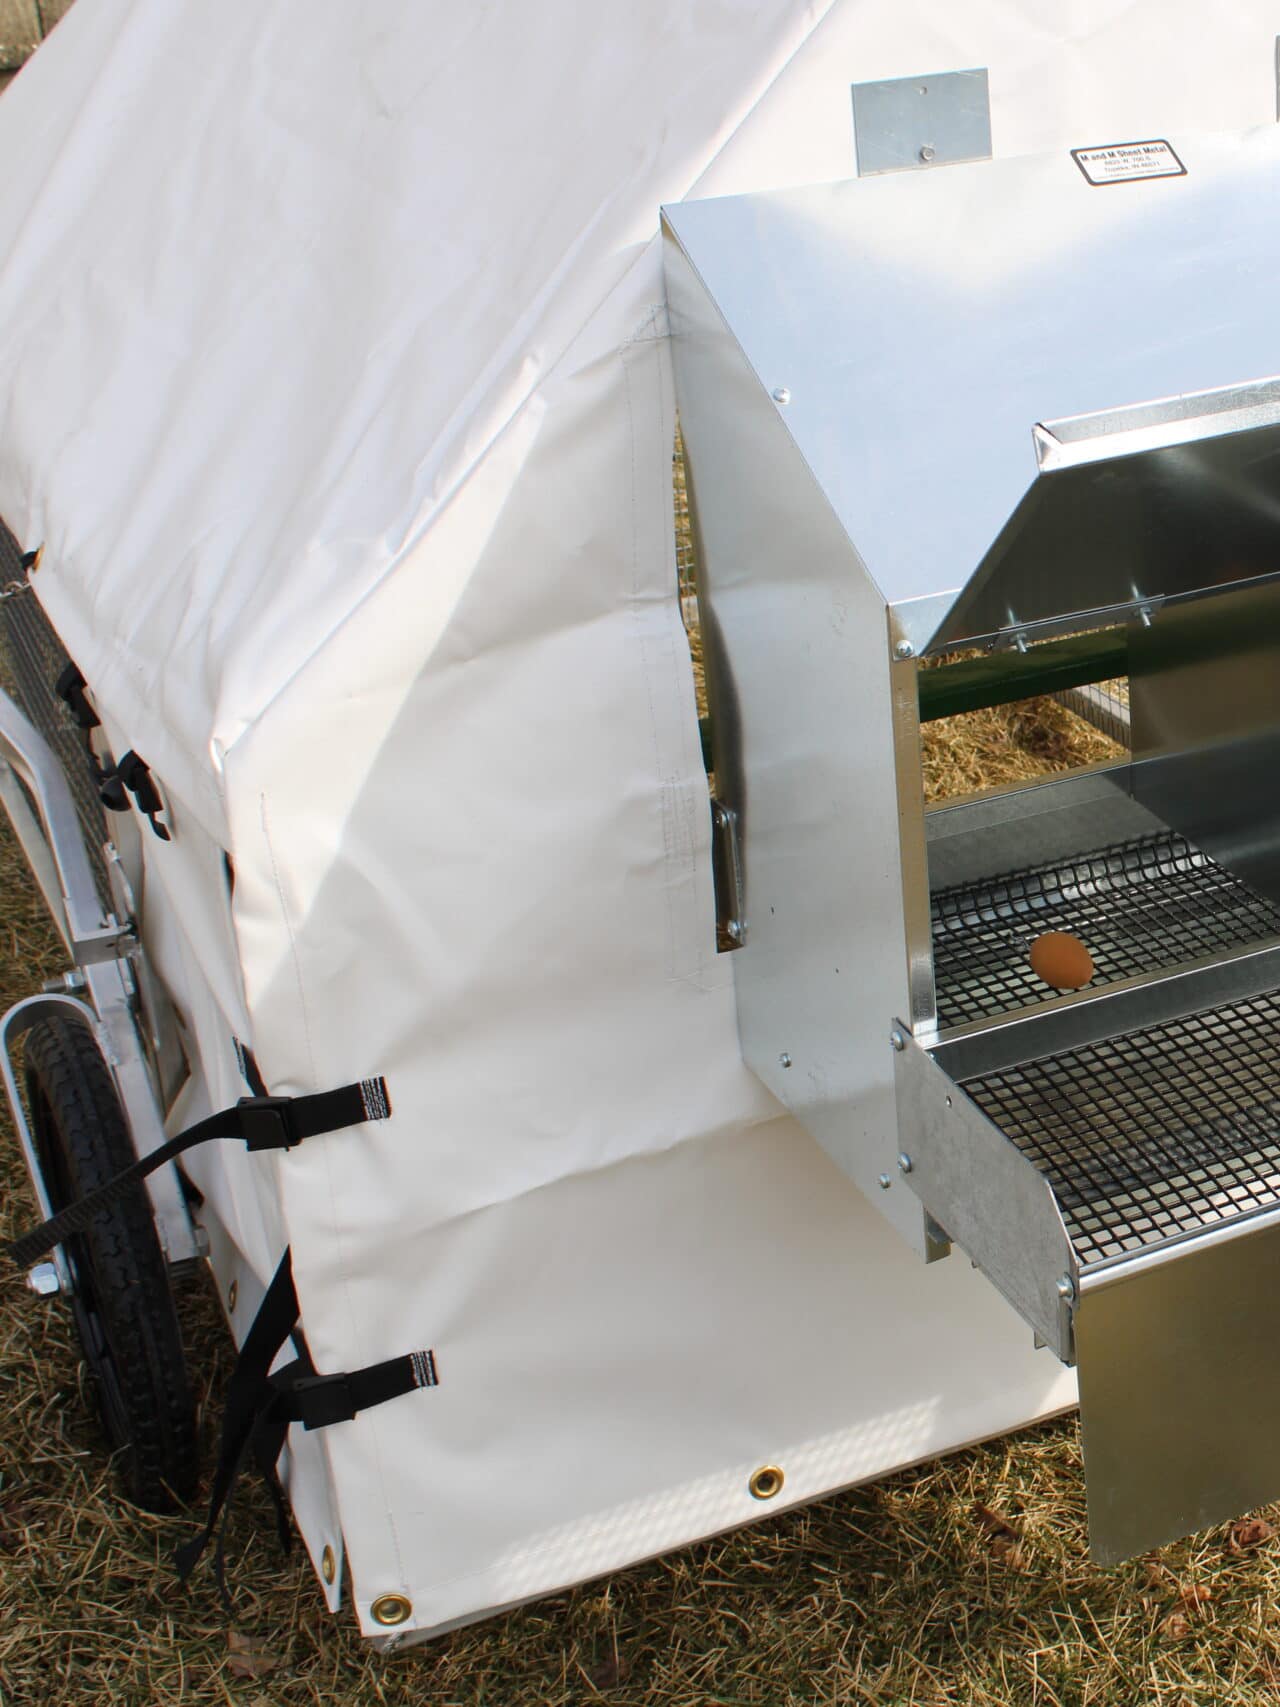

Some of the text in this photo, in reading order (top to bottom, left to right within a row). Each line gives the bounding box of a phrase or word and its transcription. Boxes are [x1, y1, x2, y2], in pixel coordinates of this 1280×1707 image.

[1080, 154, 1089, 162] M
[1090, 152, 1107, 161] and
[1117, 148, 1142, 158] Sheet
[1142, 145, 1168, 154] Metal
